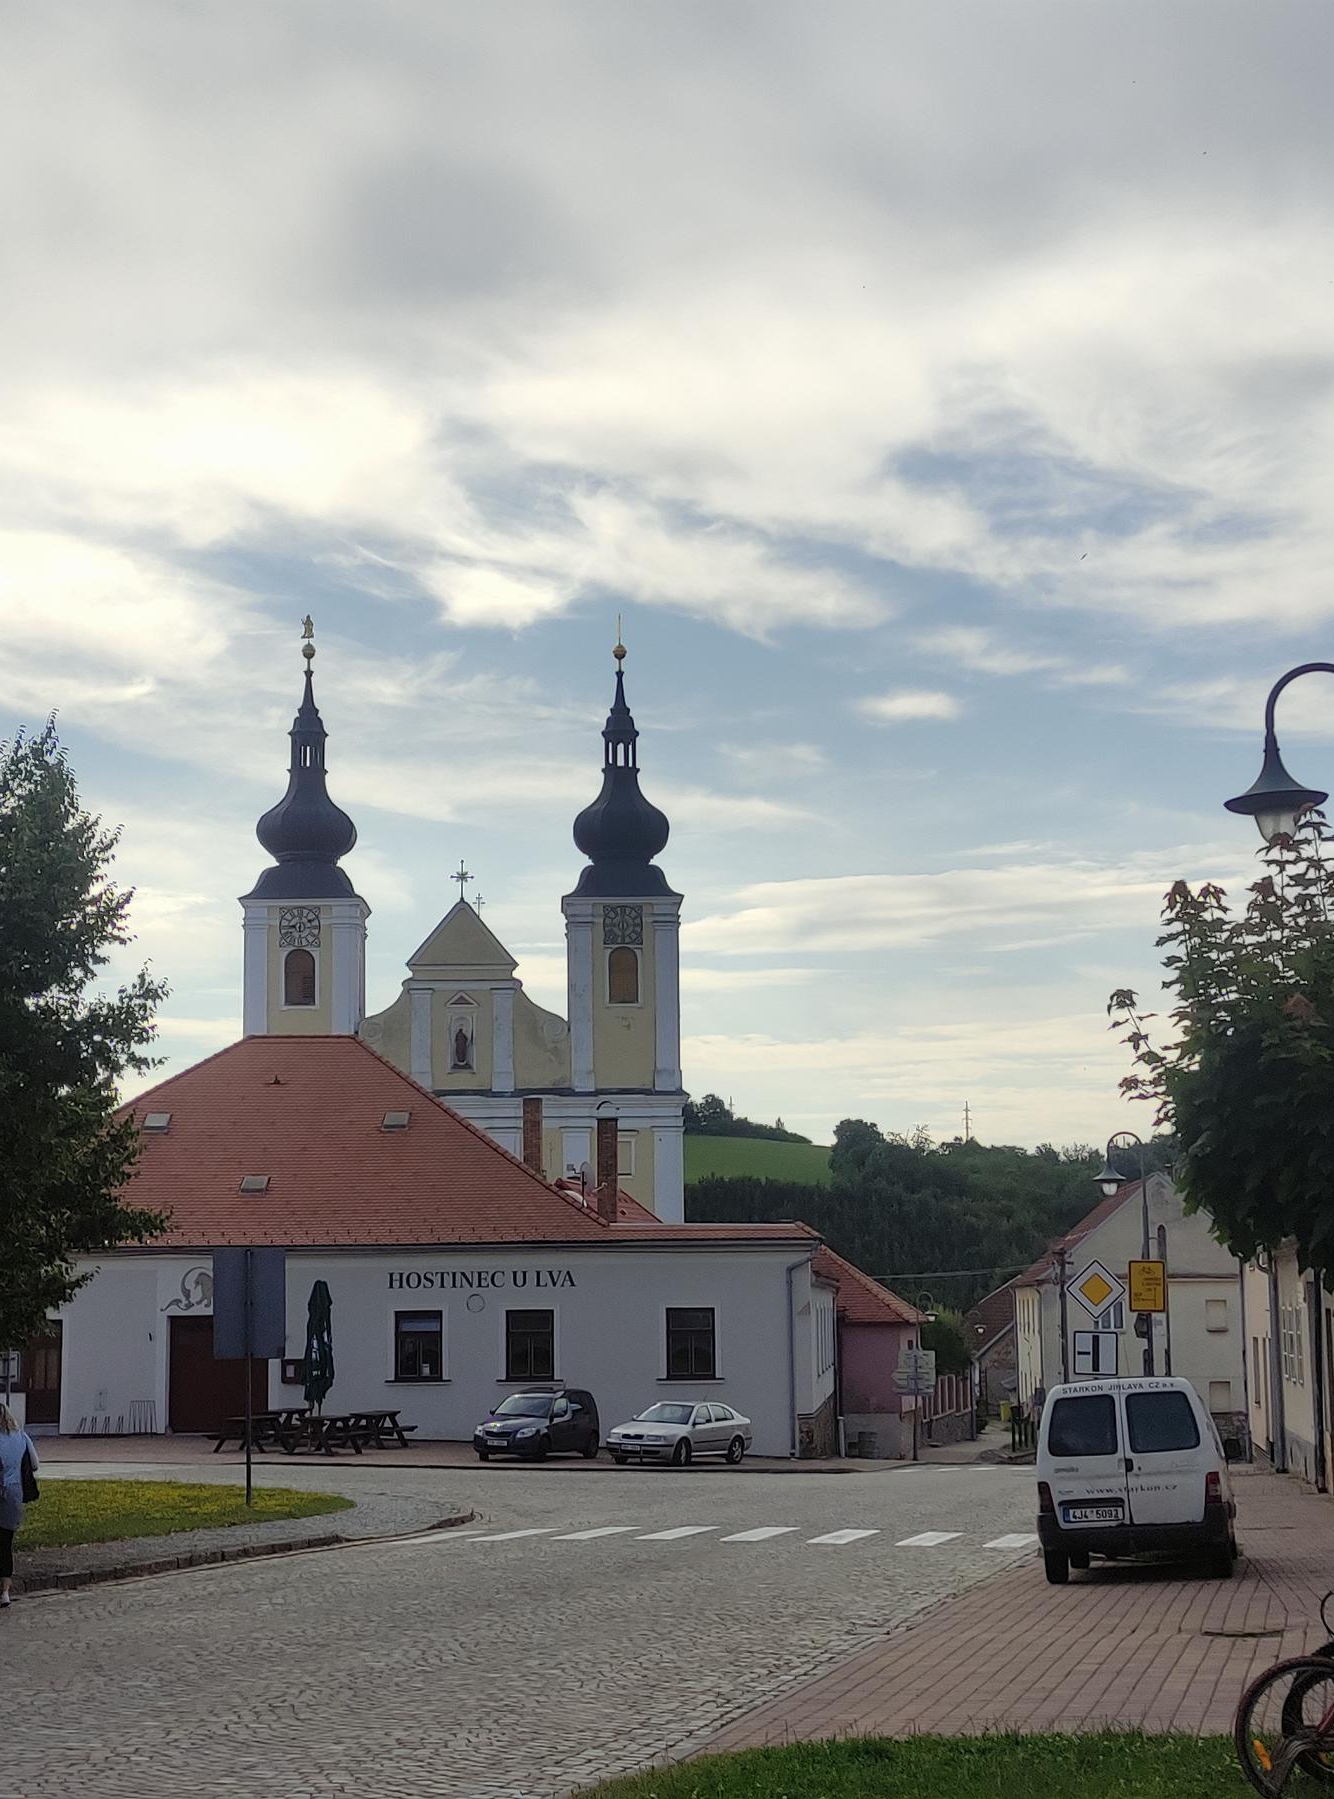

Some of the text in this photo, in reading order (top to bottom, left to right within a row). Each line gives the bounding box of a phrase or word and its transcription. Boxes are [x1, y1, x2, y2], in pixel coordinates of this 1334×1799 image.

[387, 1269, 577, 1289] HOSTINEC U LVA
[1062, 1384, 1104, 1395] STARKON
[1148, 1381, 1160, 1389] CZ
[1071, 1509, 1089, 1520] 4J4
